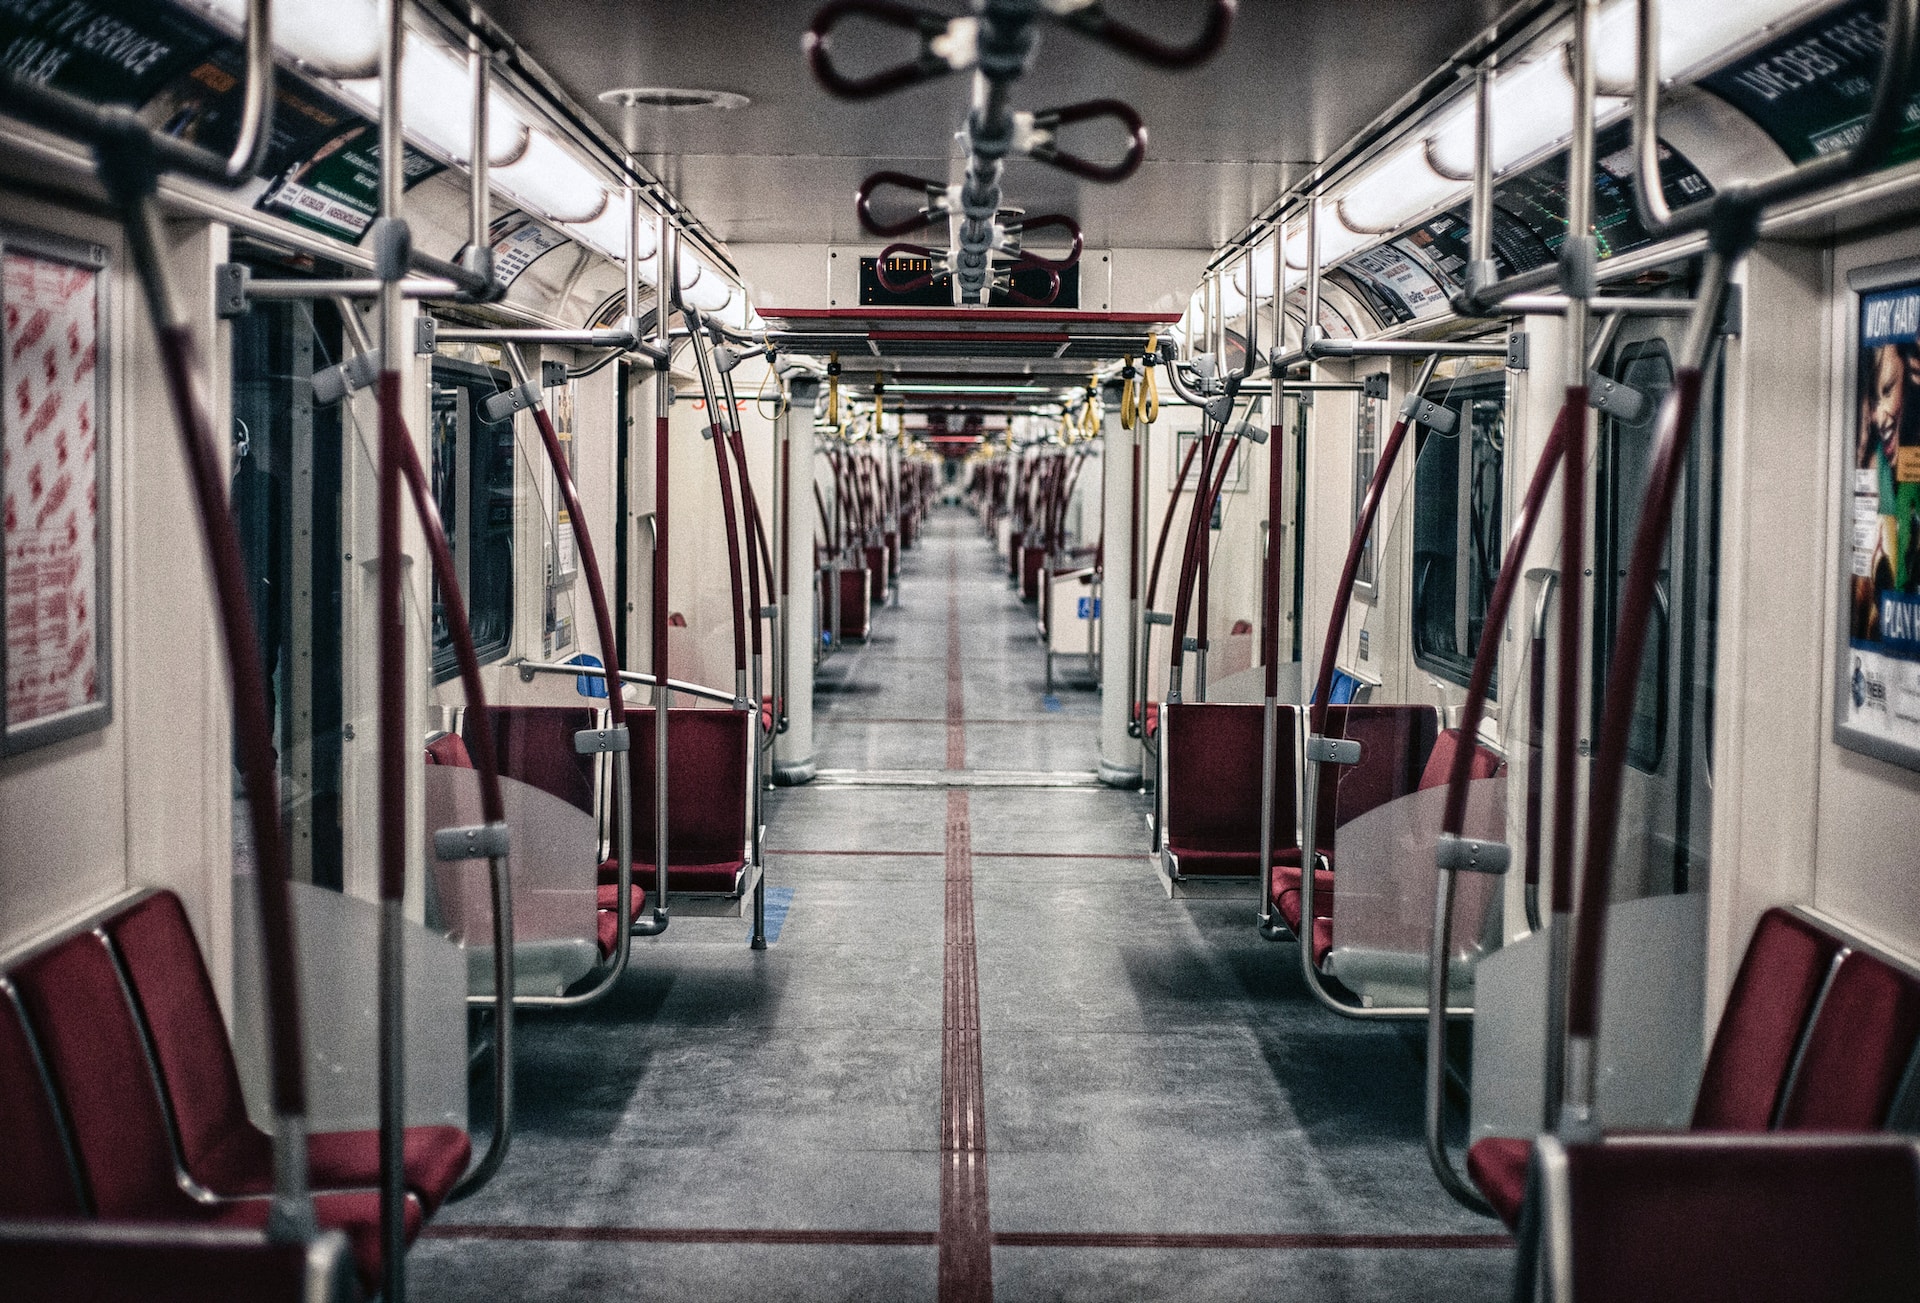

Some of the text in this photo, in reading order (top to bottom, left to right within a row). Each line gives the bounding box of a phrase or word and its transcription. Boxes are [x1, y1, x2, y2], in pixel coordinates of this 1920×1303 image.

[73, 15, 170, 75] SERVICE
[1734, 63, 1802, 100] LIVE
[1771, 38, 1850, 82] DEBT
[1866, 300, 1895, 338] WORK
[1883, 599, 1912, 640] PLAY
